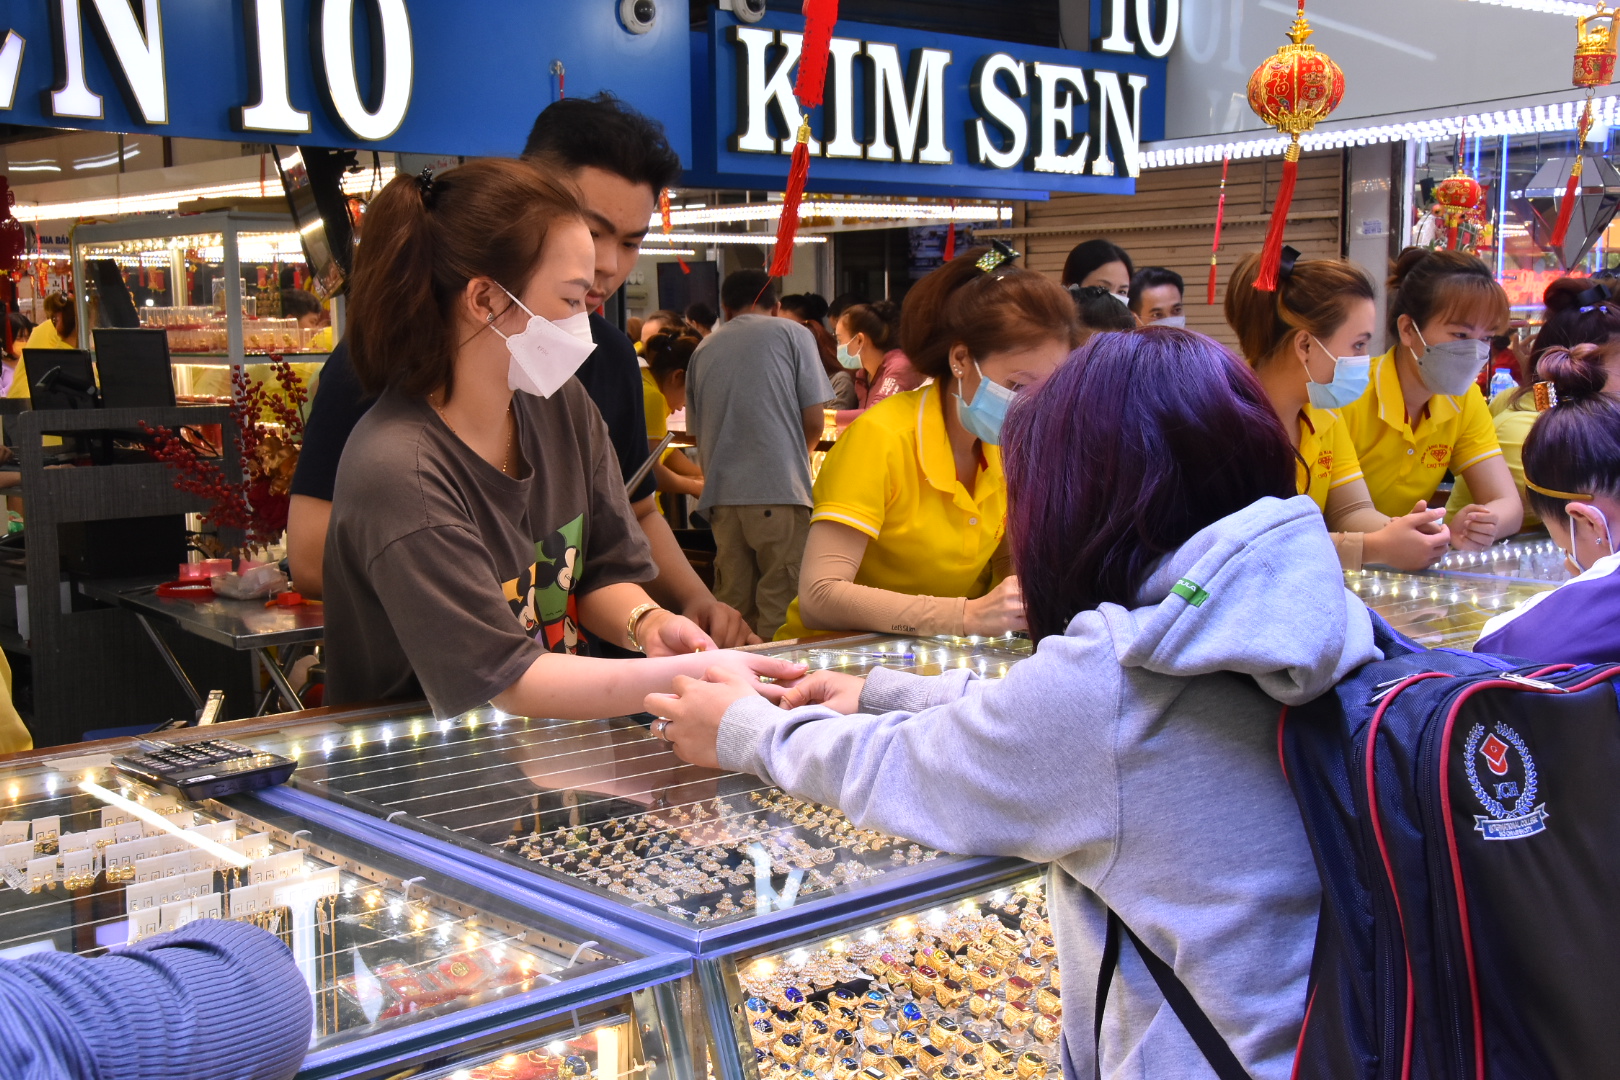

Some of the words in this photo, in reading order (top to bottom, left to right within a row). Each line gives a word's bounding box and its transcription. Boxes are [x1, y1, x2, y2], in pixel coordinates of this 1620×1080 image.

[0, 0, 169, 124] N
[736, 25, 954, 165] KIM
[975, 52, 1148, 178] SEN
